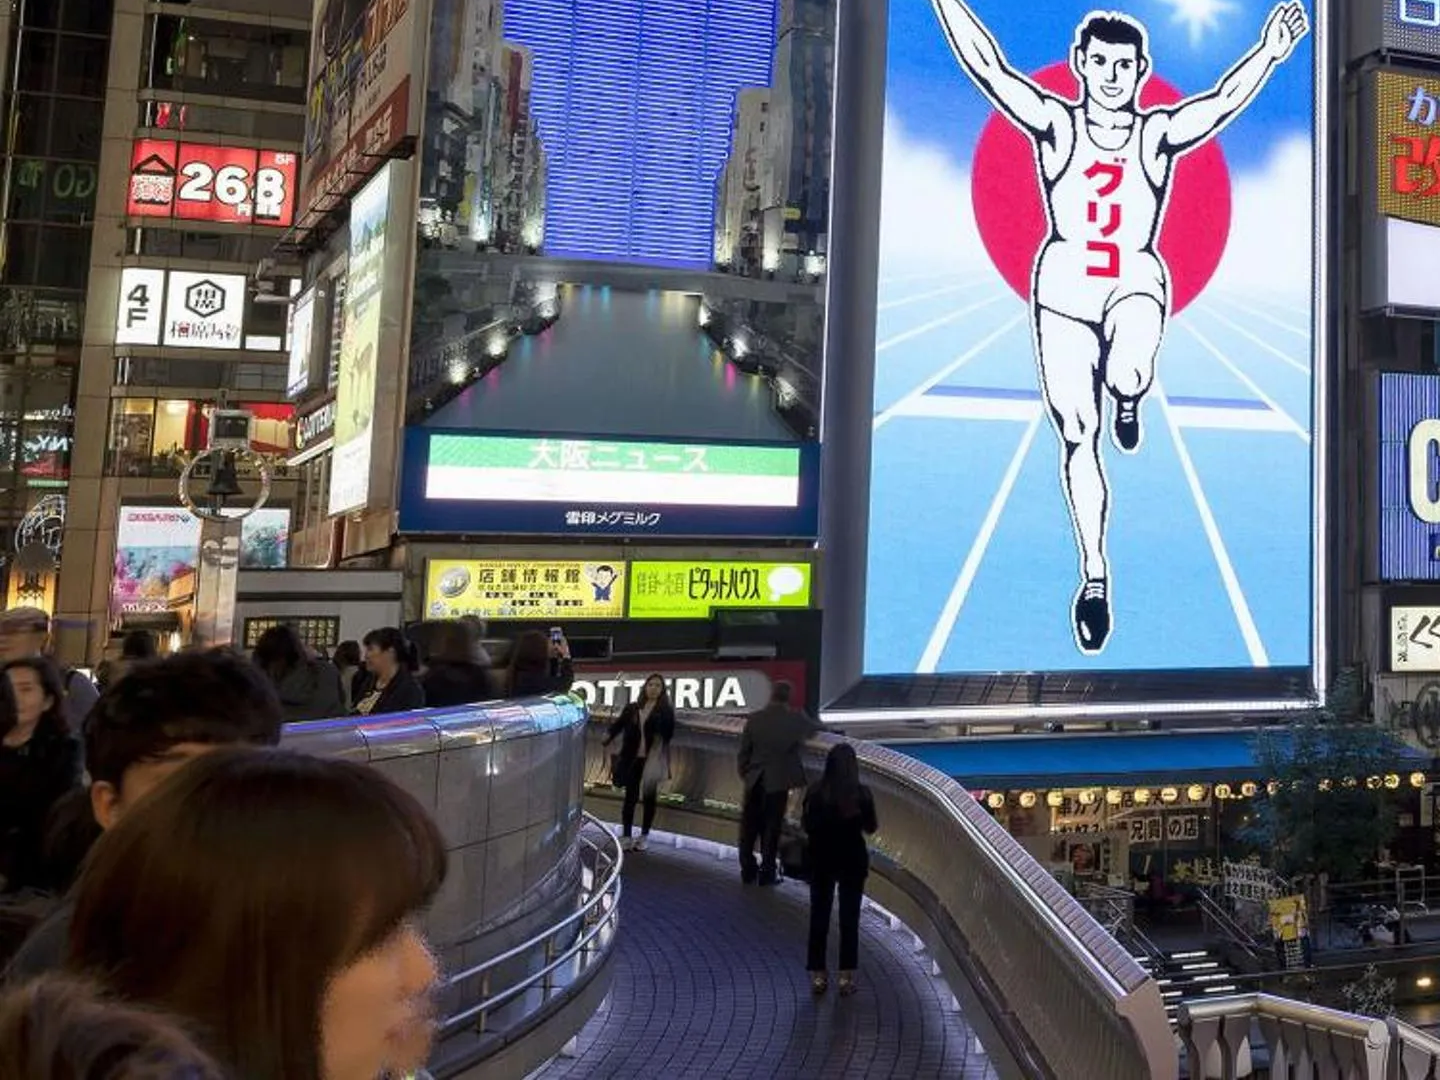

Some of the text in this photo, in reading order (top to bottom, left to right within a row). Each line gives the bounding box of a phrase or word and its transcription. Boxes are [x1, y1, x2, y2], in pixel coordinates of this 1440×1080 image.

[1082, 156, 1128, 278] グリコ
[127, 284, 149, 328] 4F
[528, 439, 711, 472] 大阪ニュース
[565, 511, 661, 526] 雪印メグミルク
[688, 567, 761, 600] ピタットハウス
[569, 677, 746, 708] OTTRIA
